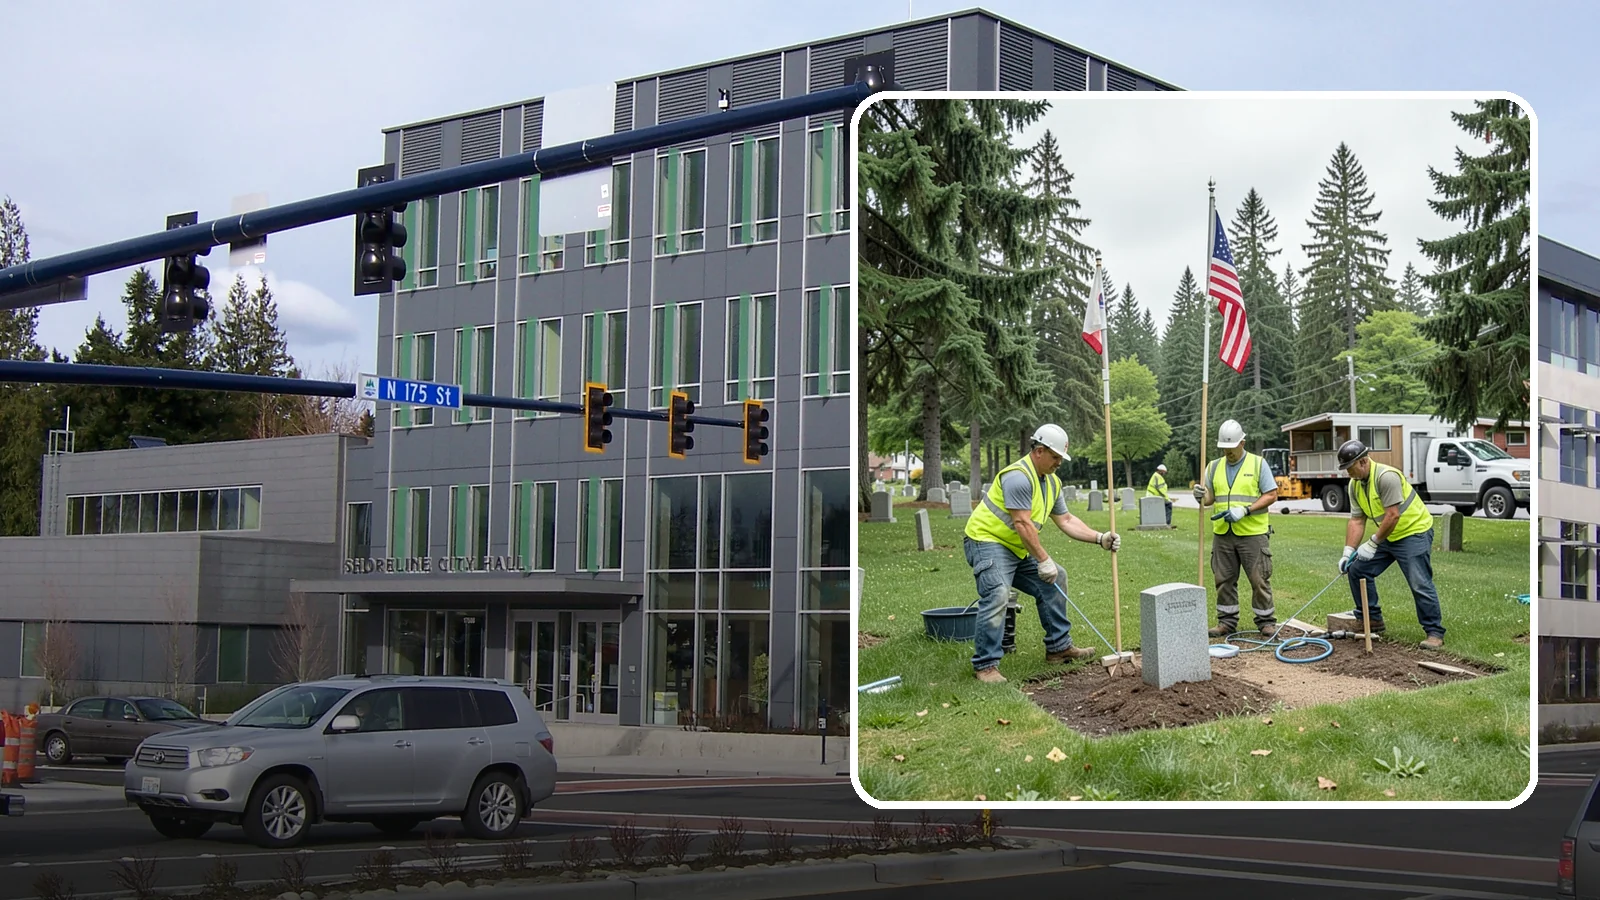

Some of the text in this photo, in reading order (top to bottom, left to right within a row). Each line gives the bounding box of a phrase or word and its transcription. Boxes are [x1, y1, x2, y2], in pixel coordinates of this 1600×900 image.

[387, 380, 451, 406] N 175 St
[344, 555, 526, 574] SHORELINE CITY HALL
